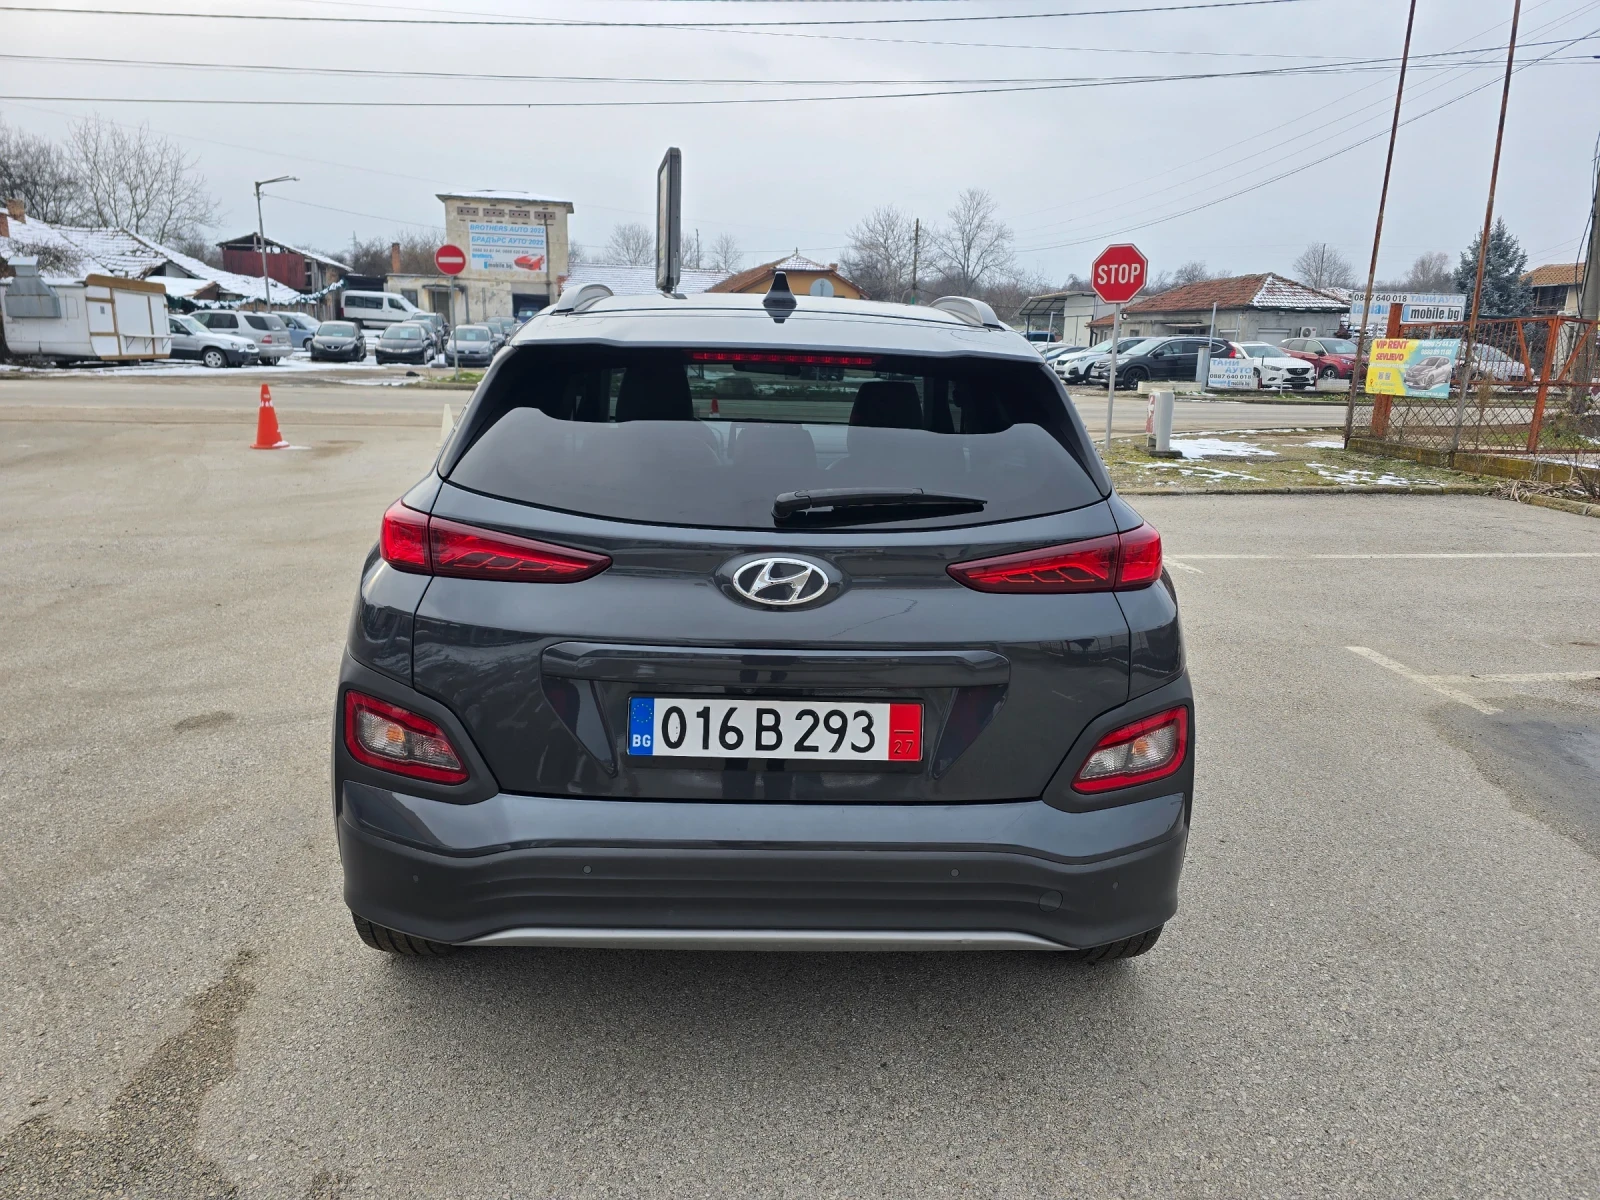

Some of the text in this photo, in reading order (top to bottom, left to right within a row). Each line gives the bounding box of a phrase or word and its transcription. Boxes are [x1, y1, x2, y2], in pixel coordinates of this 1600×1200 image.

[470, 224, 508, 232] BROTHERS
[471, 236, 506, 245] БРАДЪРС
[507, 237, 527, 245] АУТО
[1097, 263, 1141, 285] STOP
[1354, 294, 1375, 302] 087
[1376, 294, 1391, 302] 640
[1376, 341, 1408, 349] VIP RENT
[632, 734, 651, 748] BG
[893, 740, 914, 755] 27
